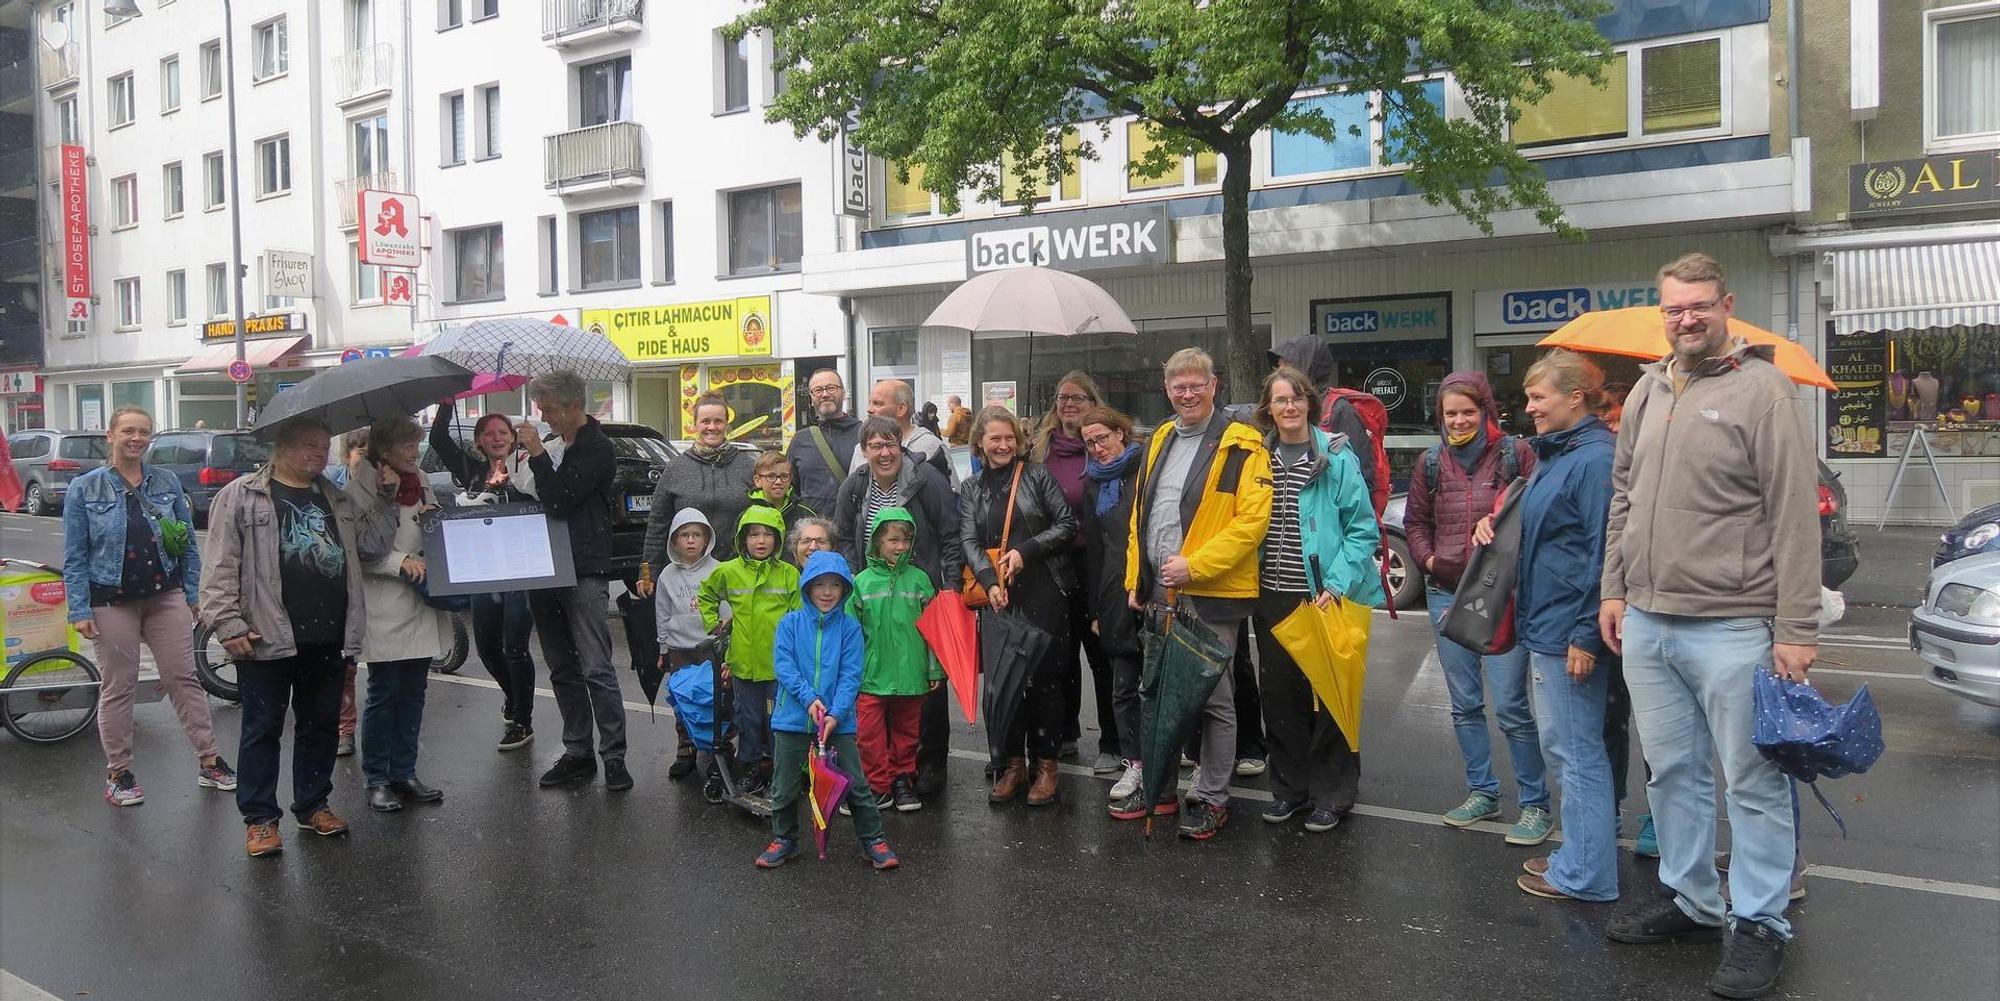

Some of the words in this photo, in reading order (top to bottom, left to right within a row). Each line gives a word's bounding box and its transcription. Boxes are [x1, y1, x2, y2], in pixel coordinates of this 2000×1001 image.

[1908, 159, 1980, 194] AL
[69, 150, 83, 270] JOSEF-APOTHEKE
[375, 247, 416, 257] APOTHEKE
[976, 232, 1045, 267] back
[1052, 219, 1157, 260] WERK
[271, 254, 309, 270] Frisuren
[614, 311, 651, 329] ÇITIR
[654, 304, 732, 326] LAHMACUN
[1507, 292, 1587, 321] back
[208, 320, 238, 337] HAND
[245, 315, 285, 333] PRAXIS
[1327, 313, 1377, 332] back
[1382, 309, 1438, 329] WERK
[667, 326, 677, 338] &
[638, 340, 668, 356] PIDE
[672, 337, 710, 354] HAUS
[1848, 352, 1865, 362] AL
[1831, 364, 1882, 375] KHALED
[1371, 386, 1398, 395] VIELFALT
